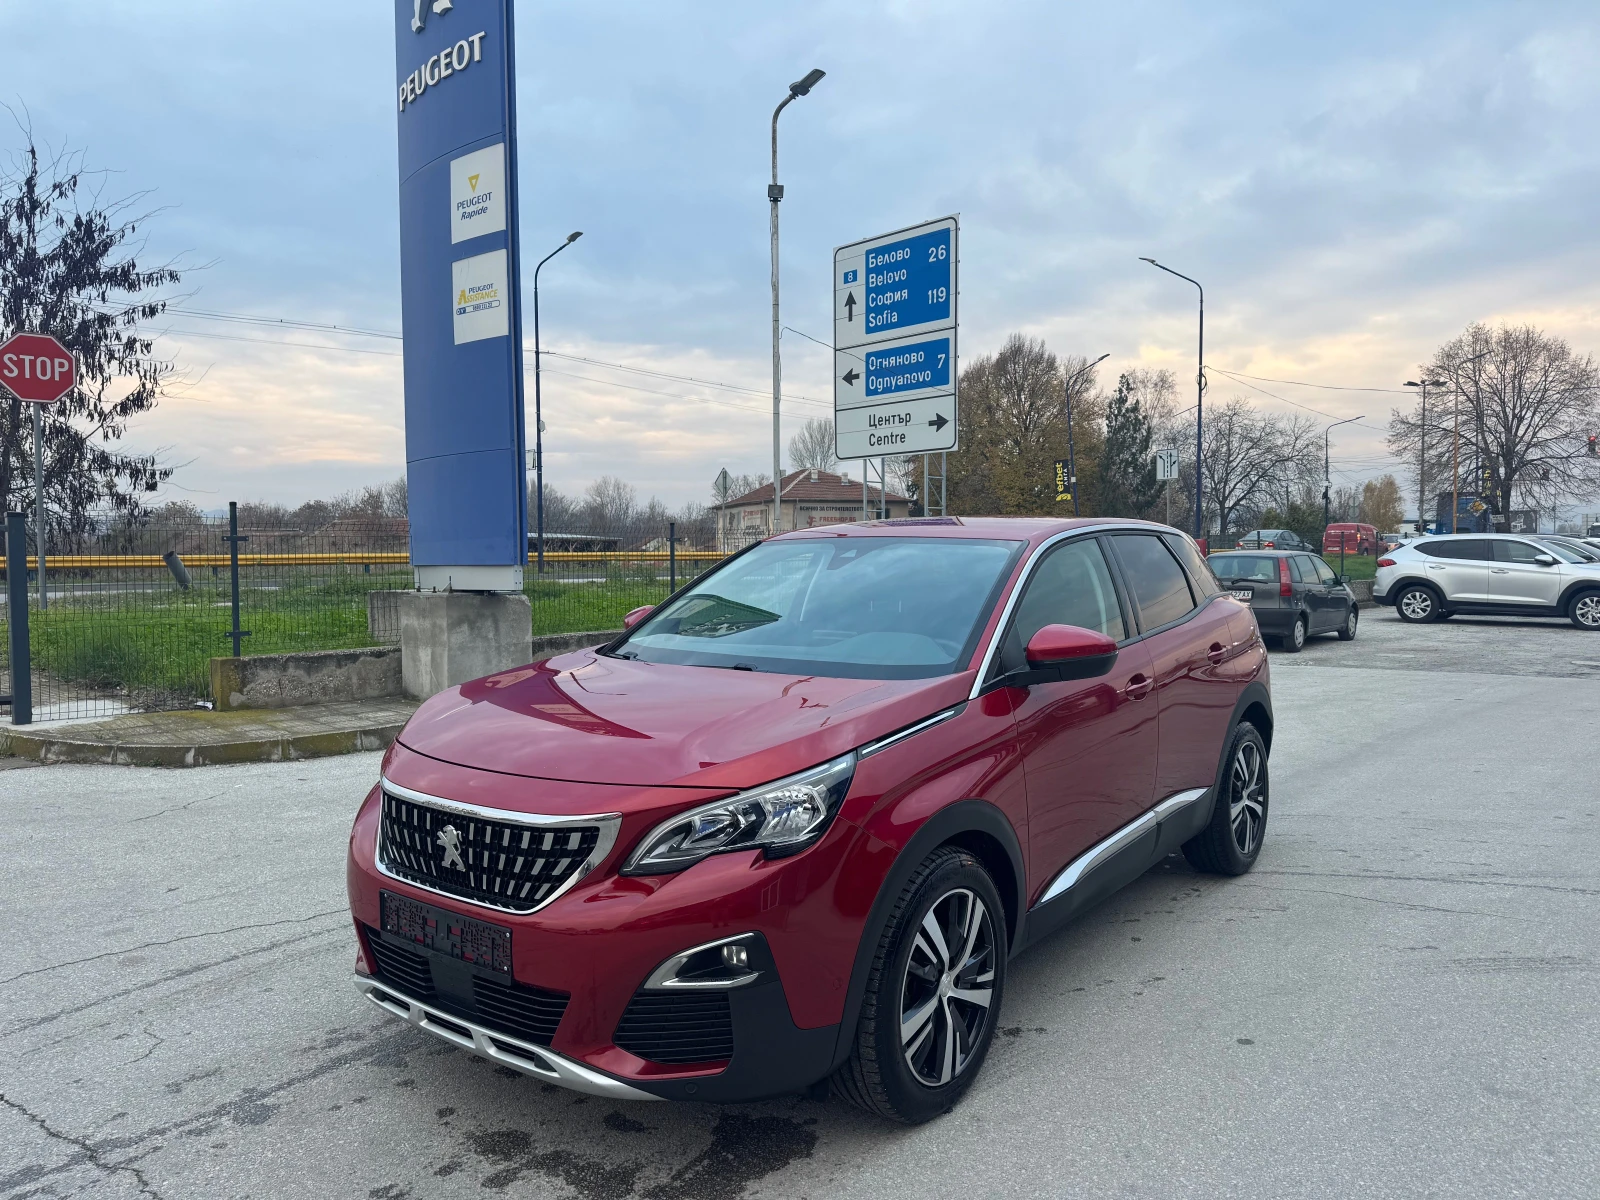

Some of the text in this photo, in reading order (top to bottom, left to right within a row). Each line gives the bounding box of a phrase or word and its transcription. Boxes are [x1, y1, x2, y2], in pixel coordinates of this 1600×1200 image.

[399, 31, 486, 112] PEUGEOT
[456, 192, 493, 211] PEUGEOT
[461, 205, 488, 221] Rapide
[868, 245, 946, 268] Белово 26
[847, 272, 853, 281] 8
[869, 269, 907, 287] Belovo
[468, 283, 494, 294] PEUGEOT
[869, 287, 946, 307] София 119
[868, 310, 898, 327] Sofia
[3, 353, 69, 381] STOP
[868, 351, 946, 370] Огняново 7
[868, 370, 931, 392] Ognyanovo
[868, 412, 911, 428] Център
[868, 431, 906, 446] Centre
[1055, 462, 1064, 492] efbet
